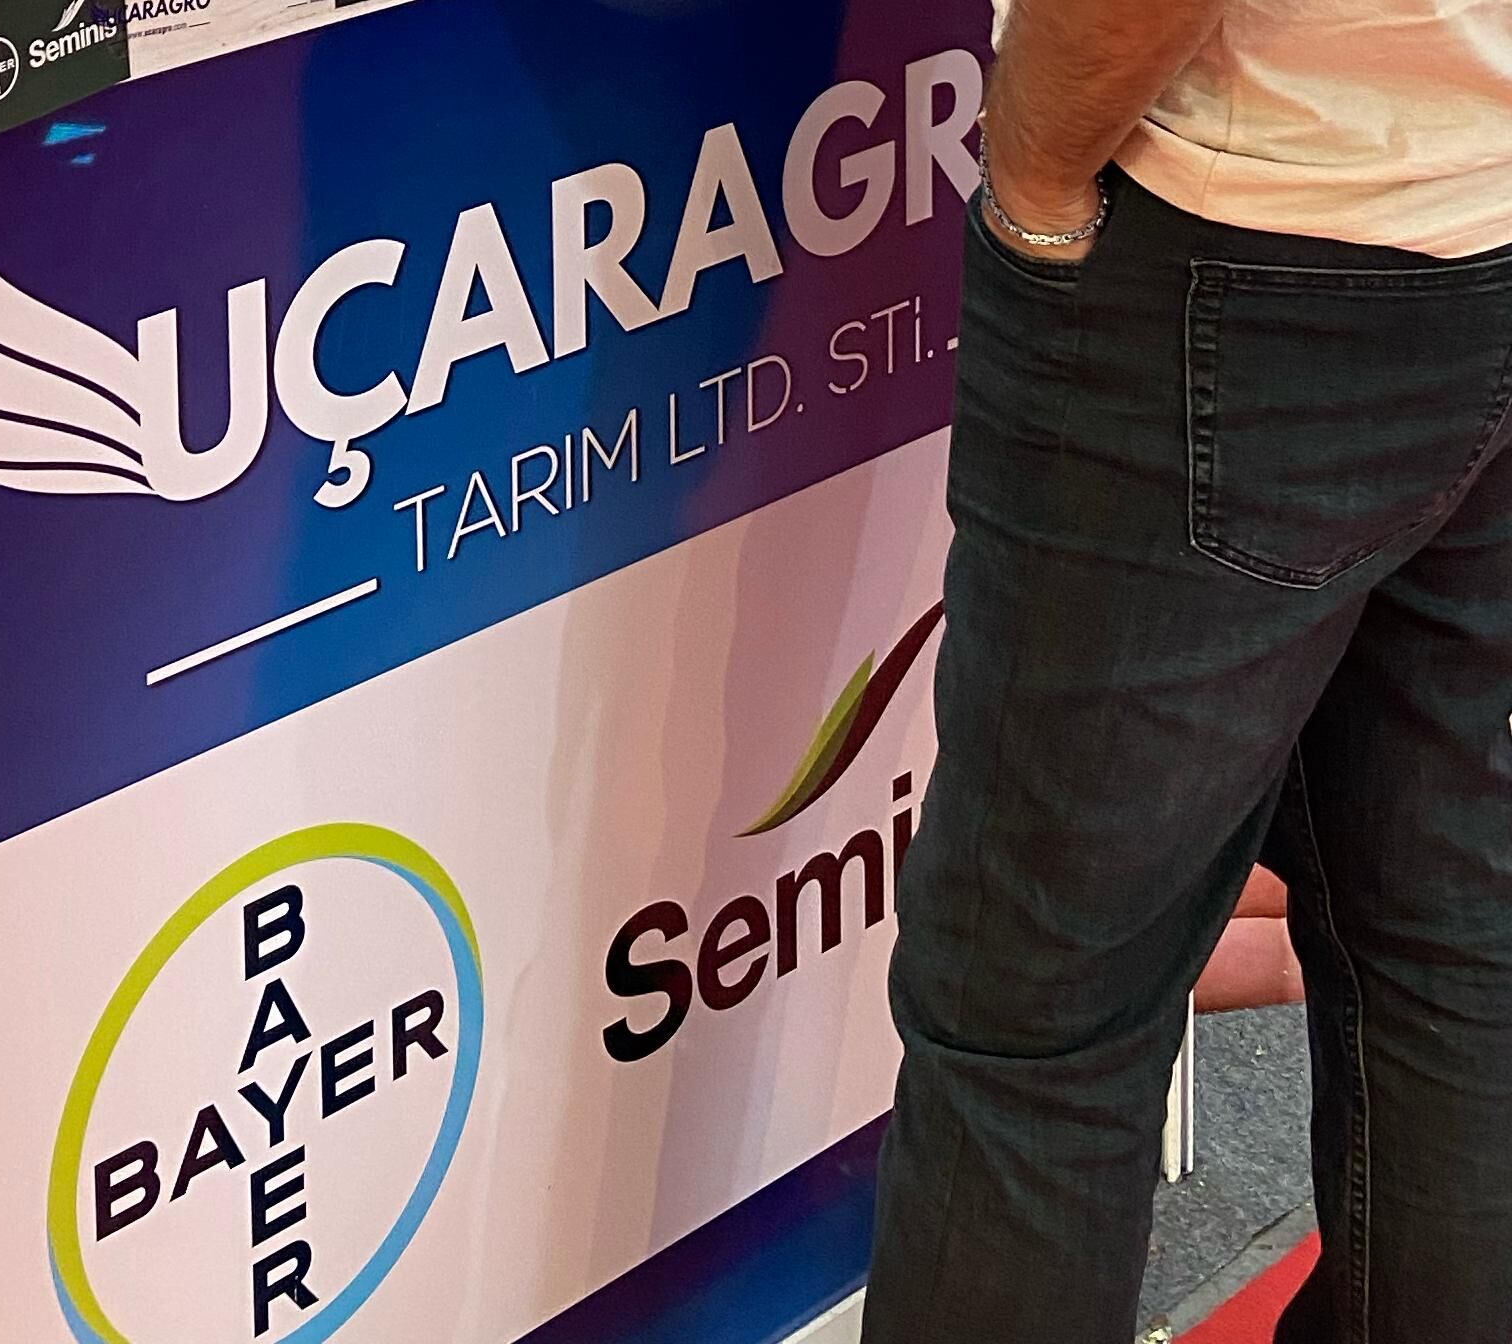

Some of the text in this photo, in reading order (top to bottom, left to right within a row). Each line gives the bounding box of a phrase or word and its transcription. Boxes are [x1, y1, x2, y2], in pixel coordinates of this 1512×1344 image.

[28, 17, 118, 69] Seminis
[393, 408, 639, 572] TARIM
[668, 354, 804, 465] LTD.
[94, 988, 449, 1241] BAYER
[238, 883, 318, 1338] BAYER
